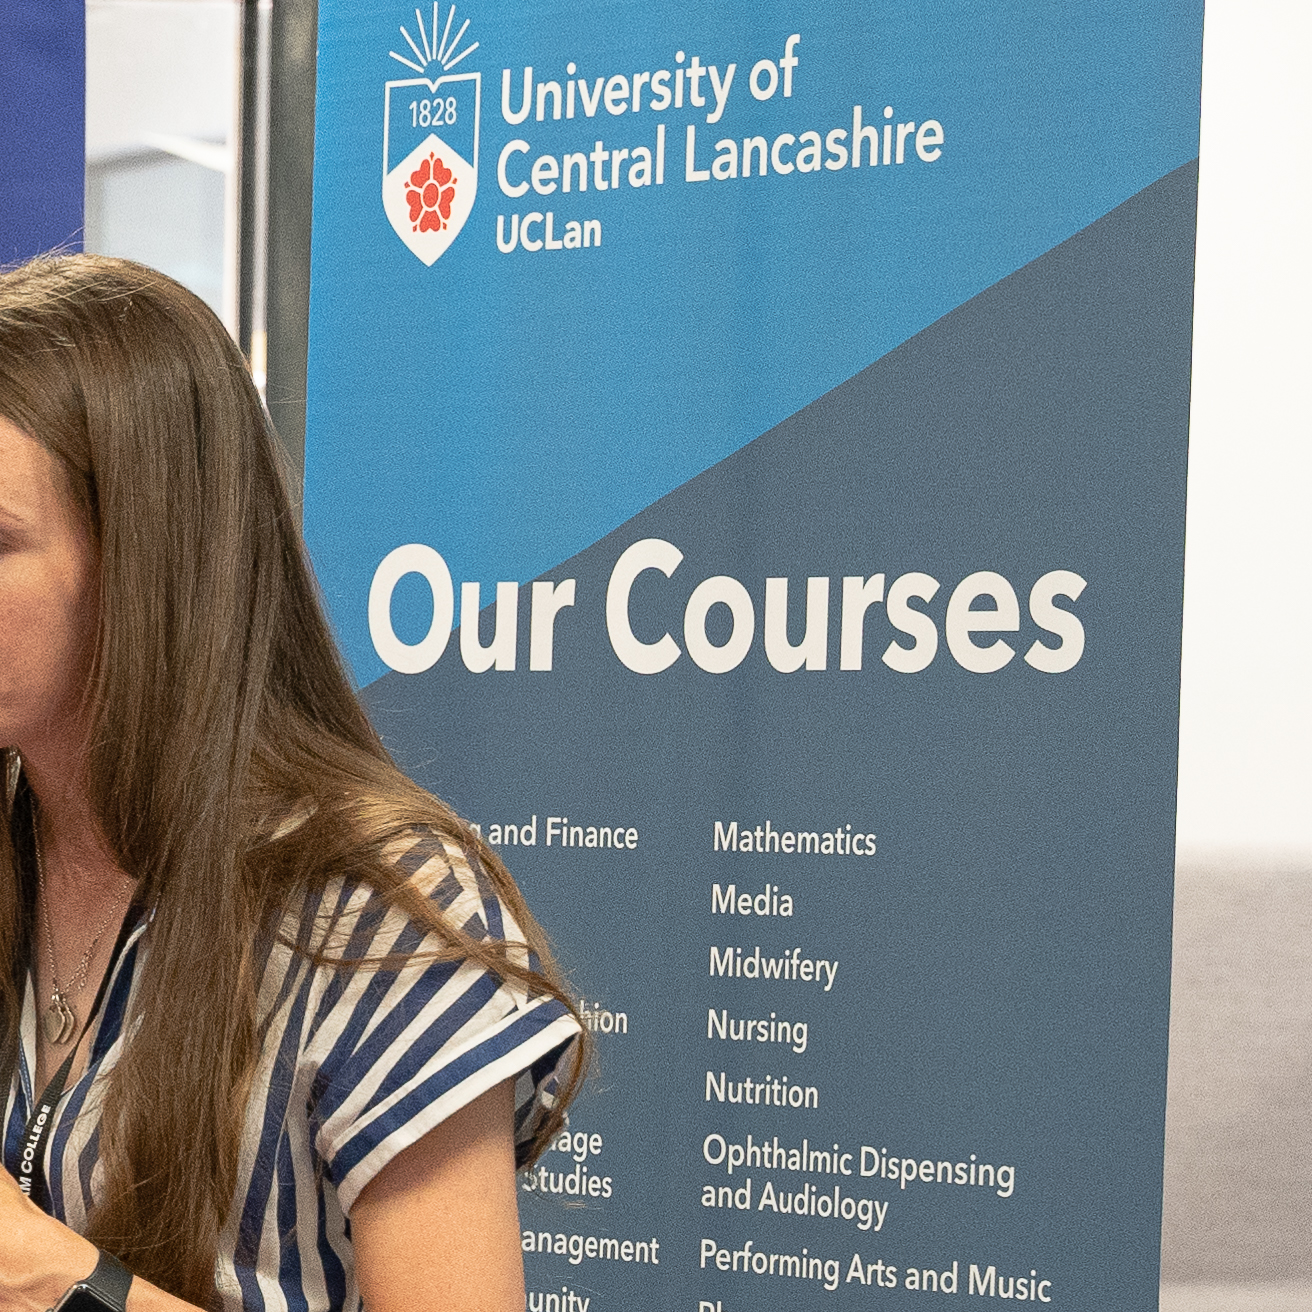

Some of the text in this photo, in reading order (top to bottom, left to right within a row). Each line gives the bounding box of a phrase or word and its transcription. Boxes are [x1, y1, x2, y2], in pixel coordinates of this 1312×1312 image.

[501, 34, 800, 125] University of
[409, 97, 457, 127] 1828
[497, 105, 944, 198] Central Lancashire
[496, 212, 601, 253] UCLan
[369, 539, 1086, 673] Our Courses
[488, 815, 537, 846] and
[546, 817, 638, 849] Finance
[714, 820, 876, 856] Mathematics
[712, 884, 793, 916] Media
[710, 946, 839, 991] Midwifery
[708, 1009, 808, 1053] Nursing
[706, 1071, 818, 1108] Nutrition
[21, 1105, 51, 1173] COLLEGE
[703, 1134, 1015, 1197] Ophthalmic Dispensing
[701, 1178, 889, 1231] and Audiology
[521, 1228, 660, 1266] anagement
[701, 1239, 1051, 1302] Performing Arts and Music
